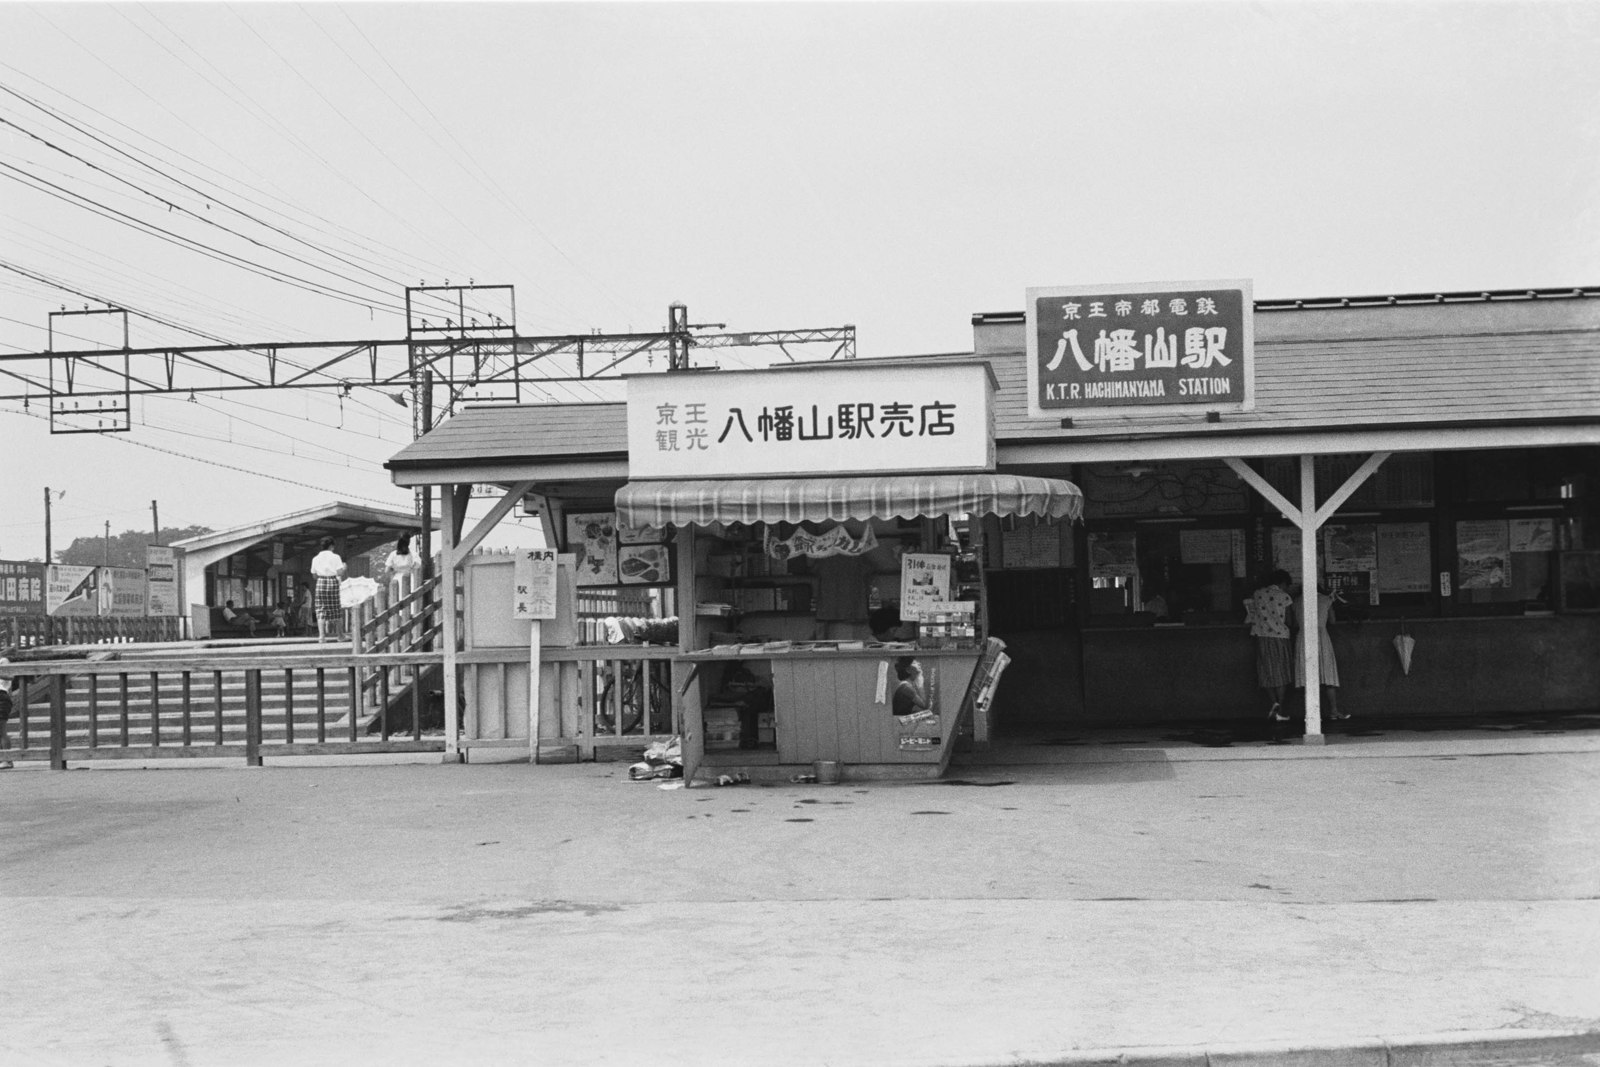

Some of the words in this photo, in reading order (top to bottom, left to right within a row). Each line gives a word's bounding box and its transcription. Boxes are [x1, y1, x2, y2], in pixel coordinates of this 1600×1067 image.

[1062, 297, 1219, 320] 京王帝都電鉄
[1046, 326, 1233, 373] 八幡山駅
[1085, 379, 1166, 400] HACHIMANYAMA
[1179, 377, 1231, 396] STATION
[655, 402, 709, 426] 京王
[717, 400, 957, 443] 八幡山駅売店
[655, 428, 709, 452] 観光
[517, 585, 528, 613] 駅長
